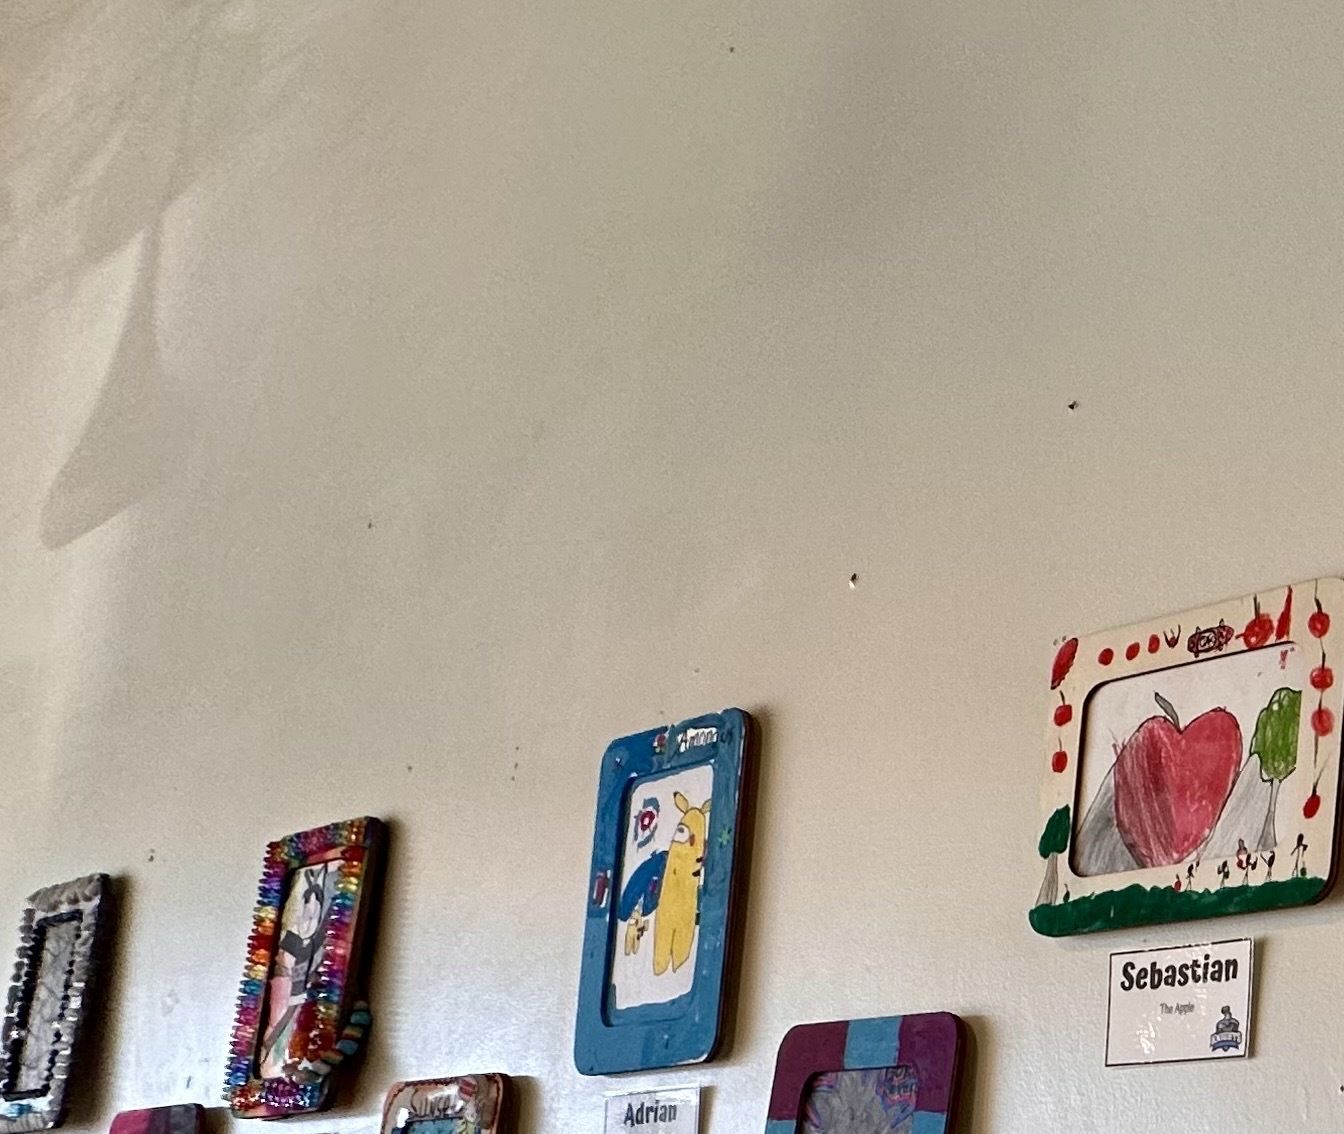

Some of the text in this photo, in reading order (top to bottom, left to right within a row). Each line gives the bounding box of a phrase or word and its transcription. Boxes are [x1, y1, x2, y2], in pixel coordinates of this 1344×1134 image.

[1120, 954, 1239, 991] Sebastian
[1160, 1002, 1195, 1015] The Apple
[623, 1100, 677, 1127] Adrian
